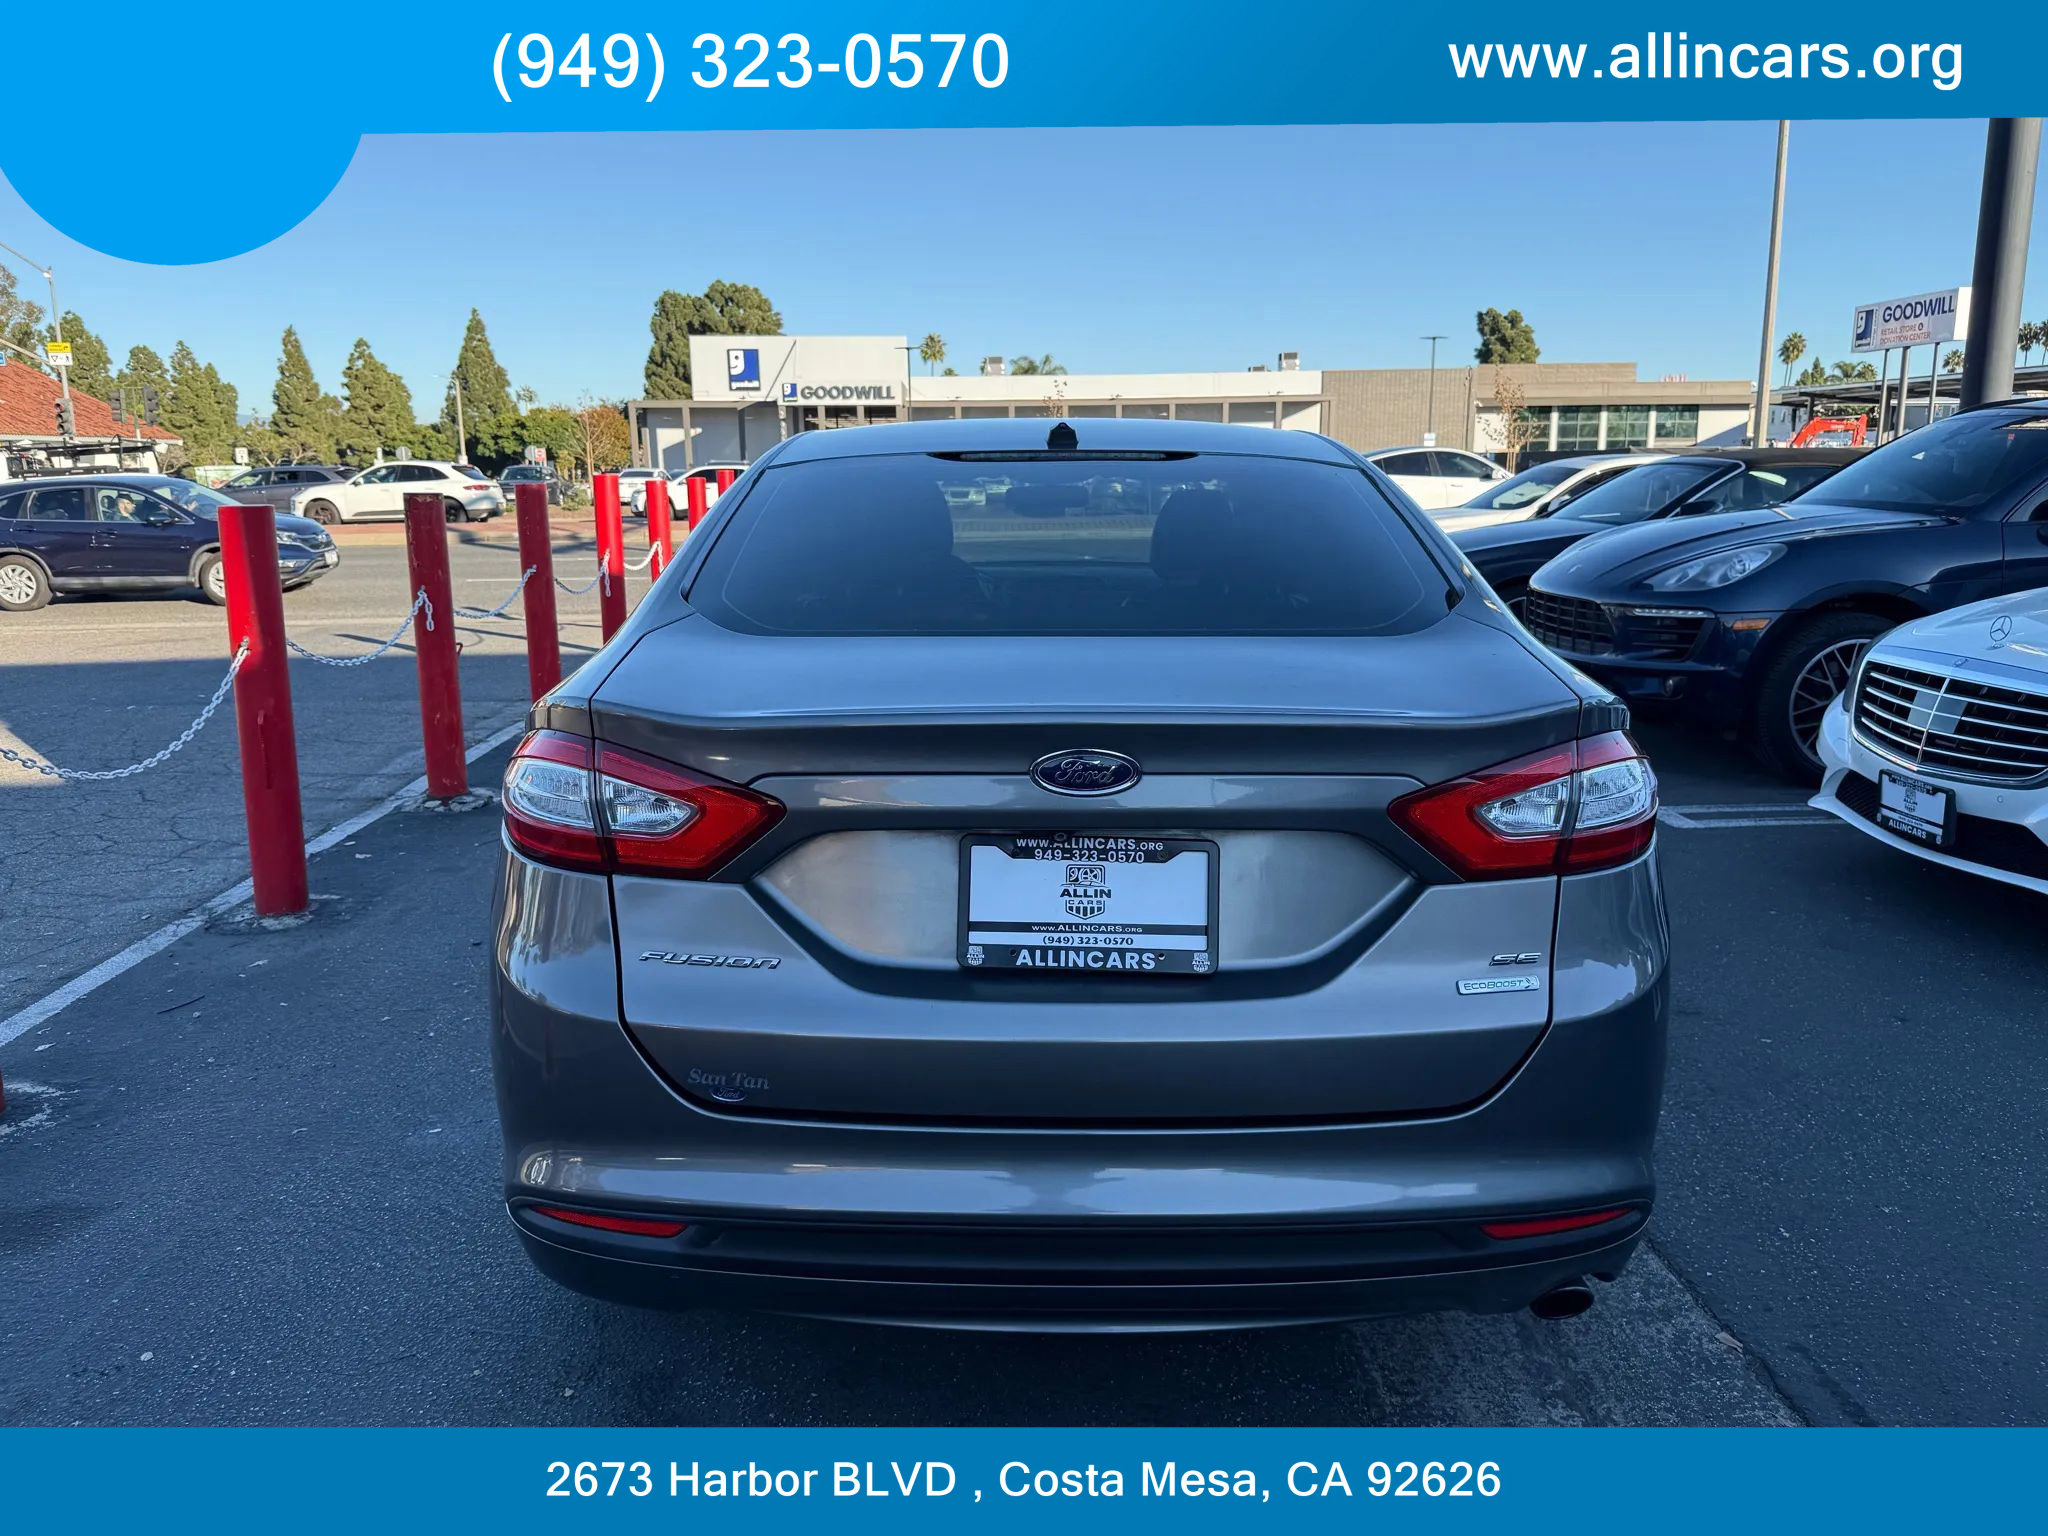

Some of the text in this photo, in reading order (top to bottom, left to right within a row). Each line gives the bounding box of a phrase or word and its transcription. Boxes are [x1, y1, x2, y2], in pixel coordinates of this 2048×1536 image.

[1882, 295, 1955, 323] GOODWILL
[800, 385, 895, 400] GOODWILL
[1055, 758, 1115, 785] Ford
[1888, 818, 1927, 840] ALLINCARS
[1034, 848, 1145, 863] 949-323-0570
[1060, 888, 1112, 899] ALLIN
[1042, 935, 1134, 946] (949) 323-0570
[639, 950, 782, 970] FUSION
[1015, 949, 1156, 969] ALLINCARS
[1488, 952, 1542, 967] SE
[687, 1067, 770, 1090] San Tan
